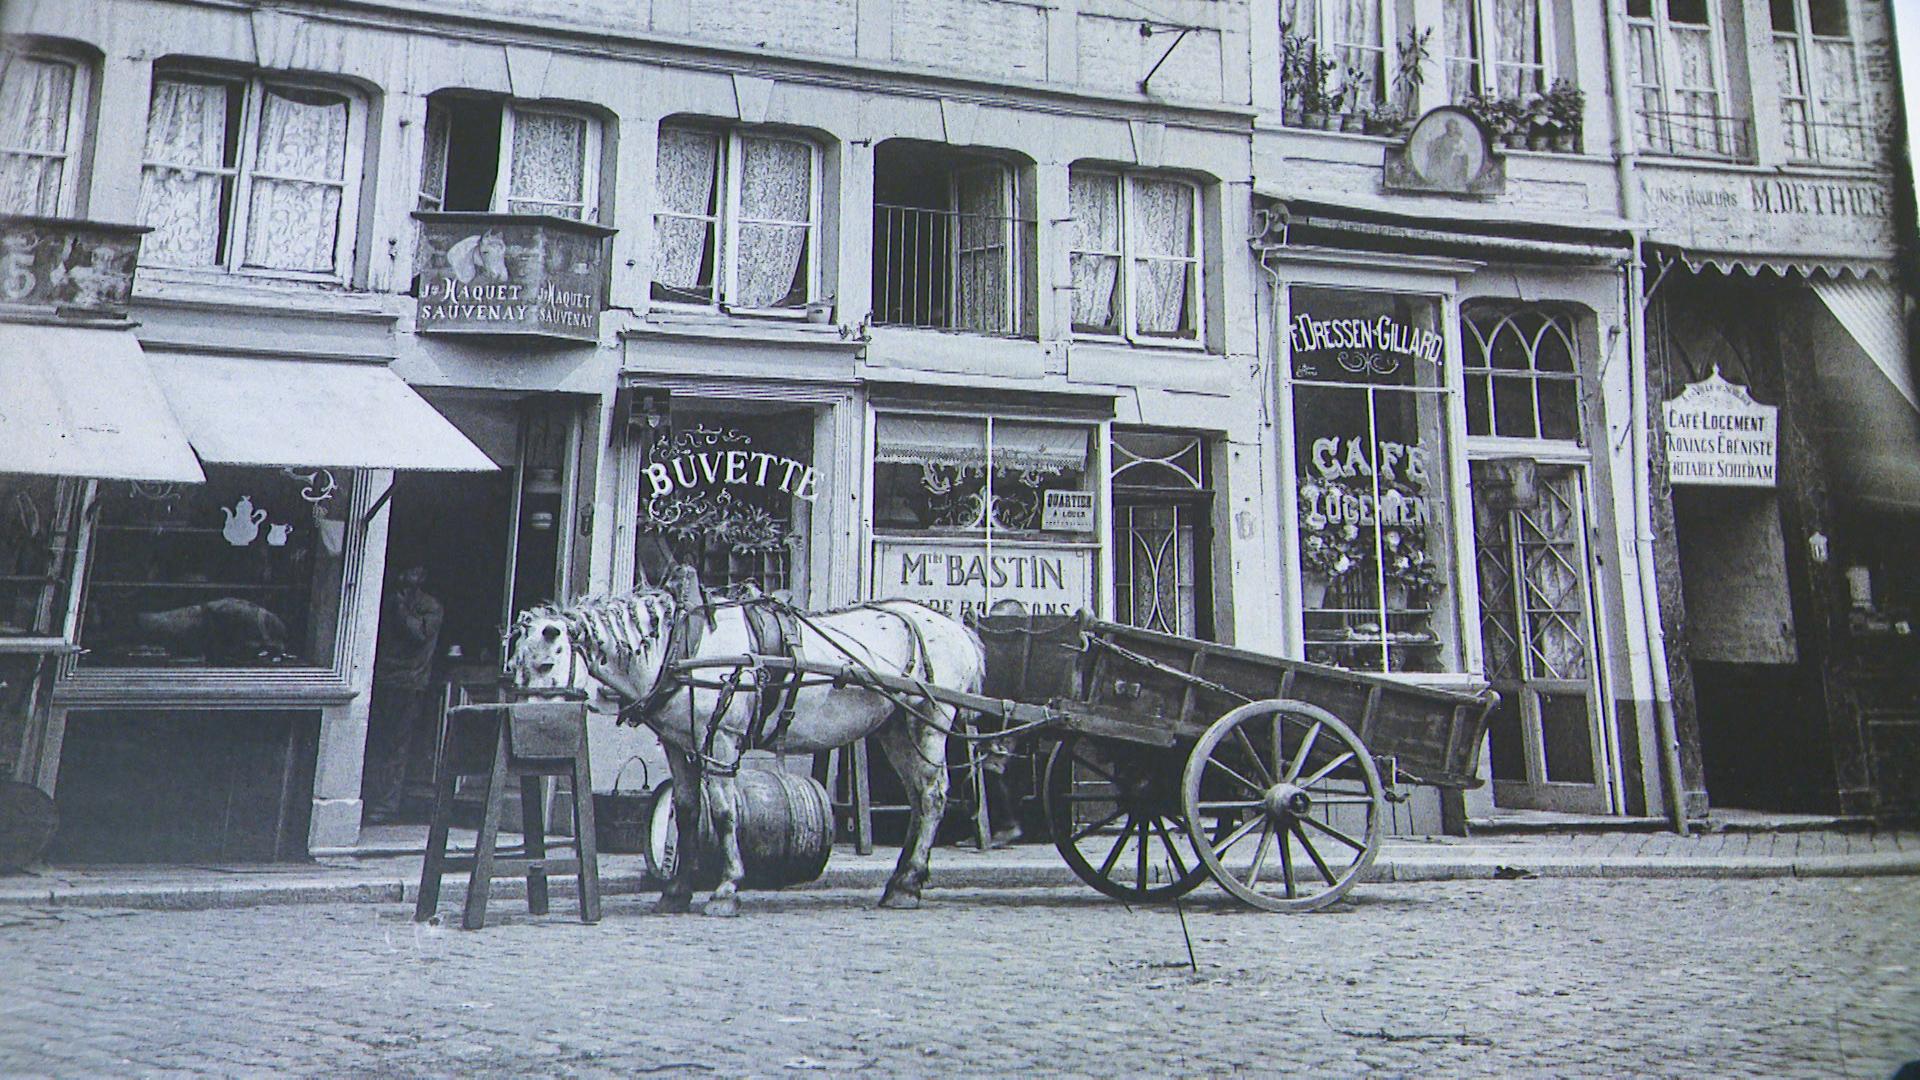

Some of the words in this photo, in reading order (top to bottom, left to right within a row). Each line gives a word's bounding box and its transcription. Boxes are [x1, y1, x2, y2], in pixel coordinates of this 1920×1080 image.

[420, 303, 529, 321] SAUVENAY
[539, 308, 593, 328] SAUVENAY
[641, 451, 825, 502] BUVETTE
[1047, 493, 1092, 508] QUARTIER
[946, 555, 1065, 590] BASTIN
